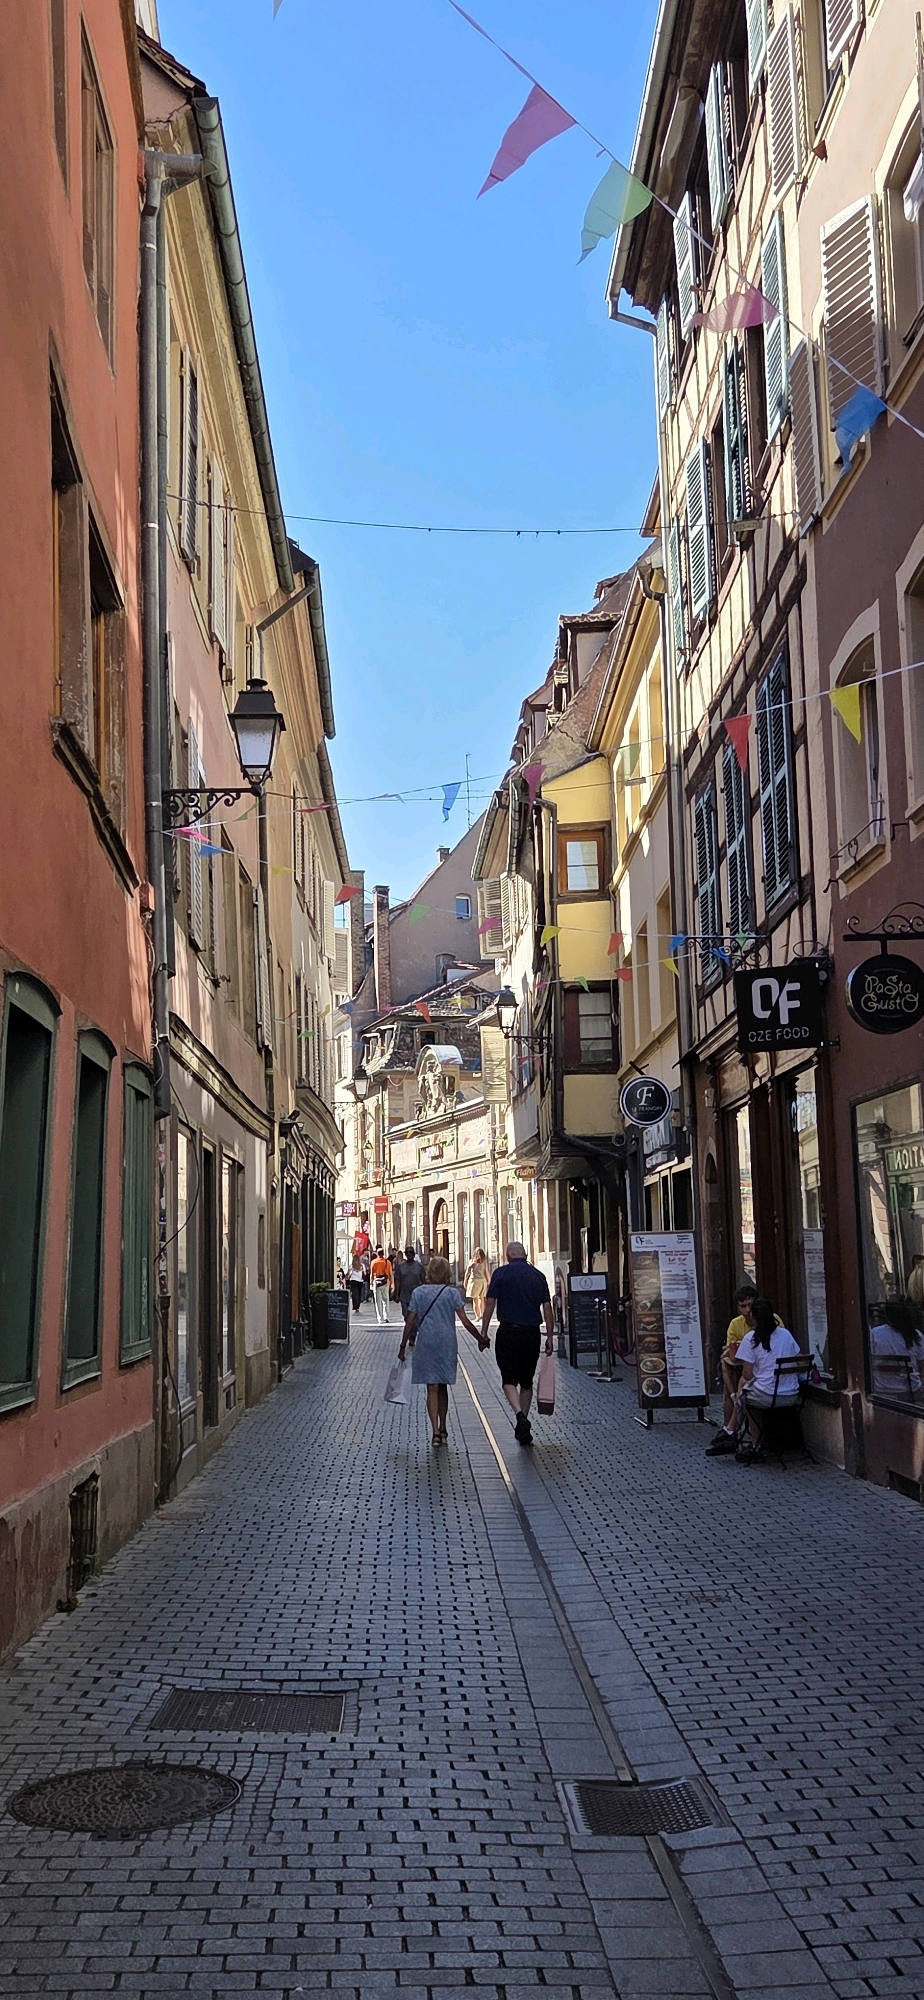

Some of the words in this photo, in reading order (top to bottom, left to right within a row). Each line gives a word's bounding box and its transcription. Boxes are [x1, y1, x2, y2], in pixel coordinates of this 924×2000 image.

[751, 977, 801, 1025] OF
[748, 1029, 773, 1043] OZE
[775, 1026, 810, 1040] FOOD
[636, 1085, 655, 1106] F
